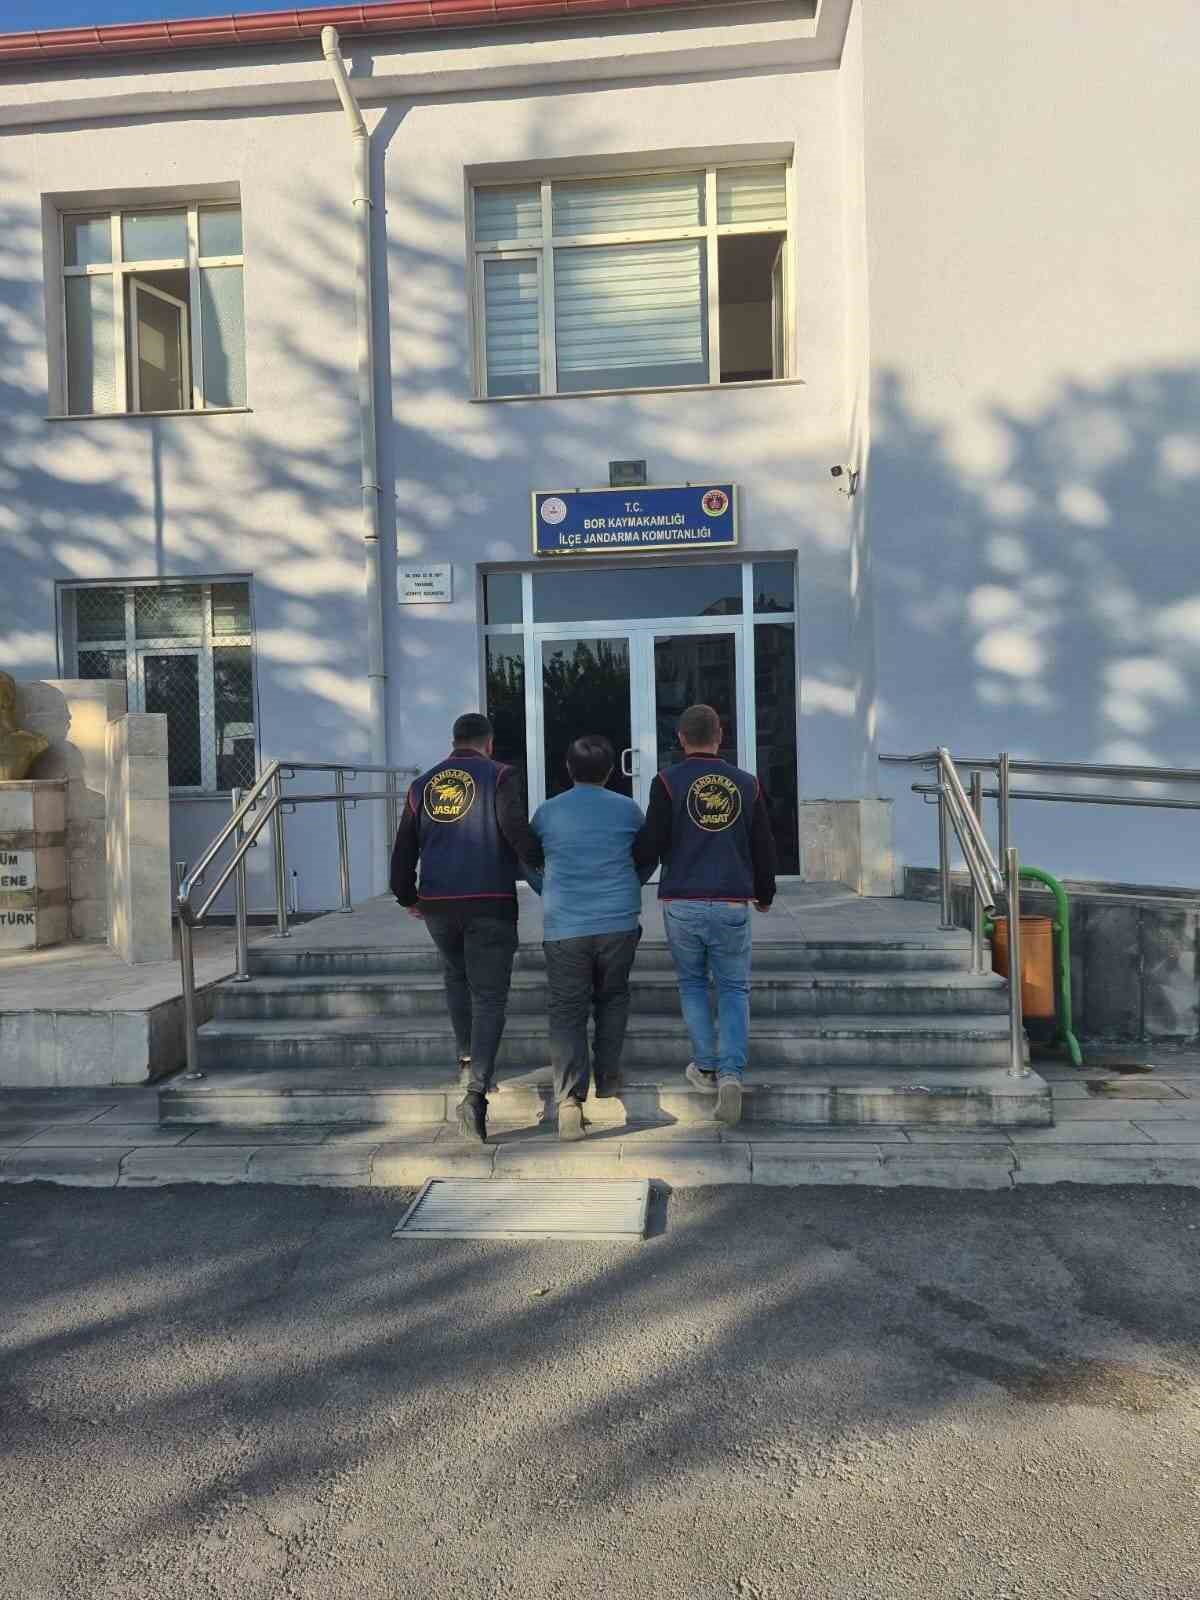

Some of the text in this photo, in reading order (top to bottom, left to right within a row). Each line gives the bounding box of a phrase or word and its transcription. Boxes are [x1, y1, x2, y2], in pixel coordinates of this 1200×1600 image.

[624, 502, 643, 513] T.C.
[583, 513, 685, 529] BOR KAYMAKAMLIĞI
[559, 526, 711, 547] İLÇE JANDARMA KOMUTANLIĞI
[432, 805, 462, 816] JASAT
[700, 813, 729, 824] JASAT
[0, 911, 34, 926] TÜRK
